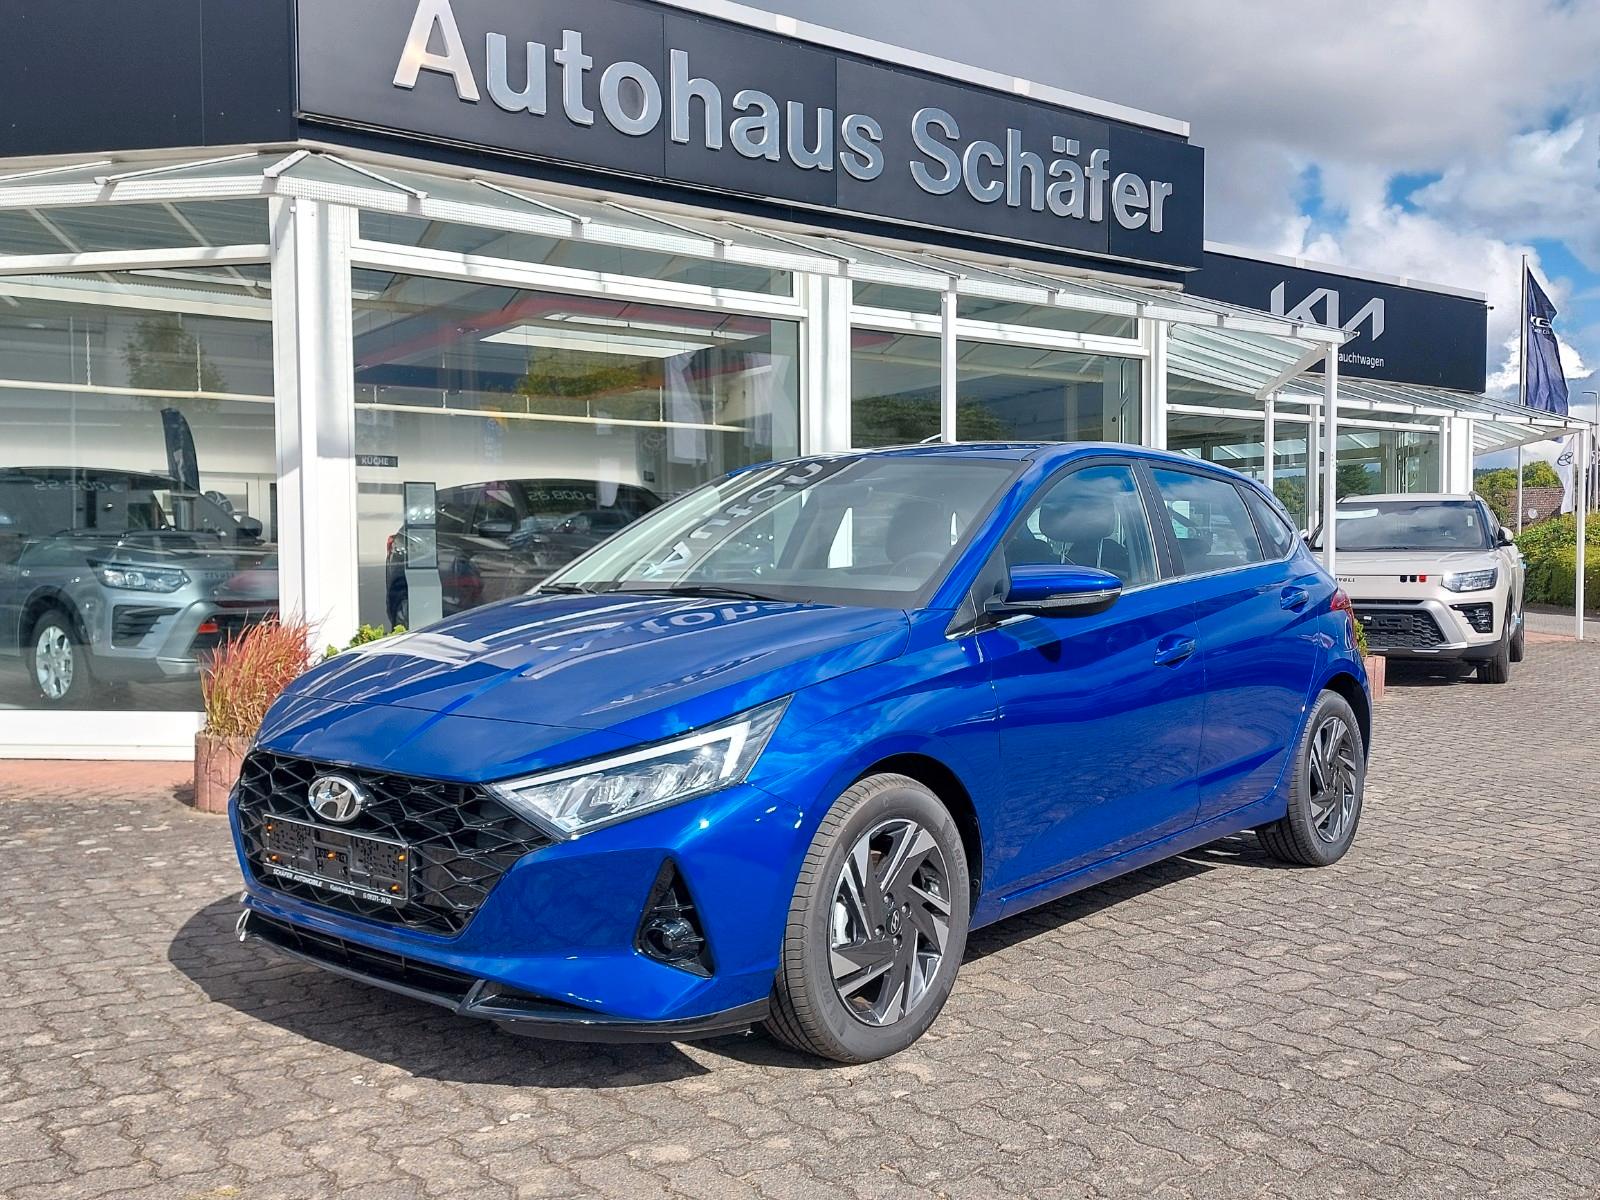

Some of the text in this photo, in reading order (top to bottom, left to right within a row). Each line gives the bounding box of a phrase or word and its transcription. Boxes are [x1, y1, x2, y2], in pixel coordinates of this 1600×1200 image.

[393, 0, 1173, 234] Autohaus Schäfer
[1337, 351, 1385, 369] auchtwagen
